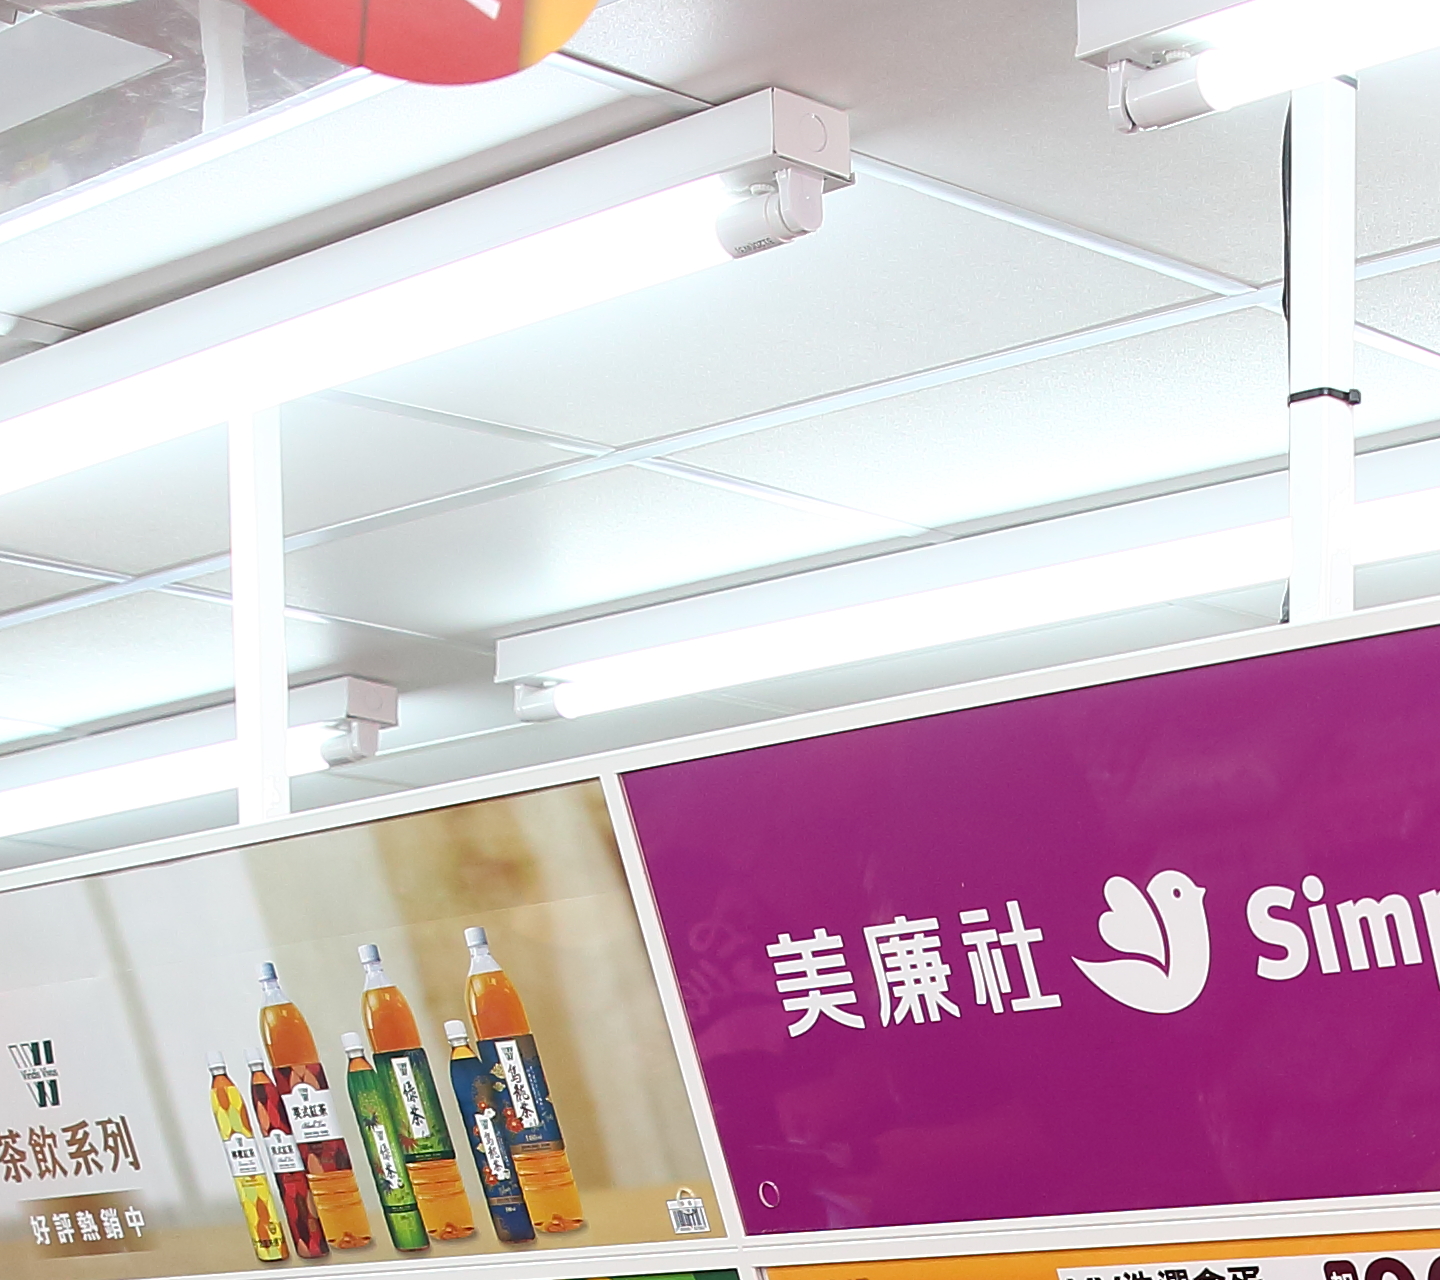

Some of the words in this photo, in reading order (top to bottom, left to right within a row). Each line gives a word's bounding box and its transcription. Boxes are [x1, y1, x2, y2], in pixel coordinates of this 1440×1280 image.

[765, 899, 1062, 1040] 美廉社
[30, 1205, 144, 1246] 好評熱銷中
